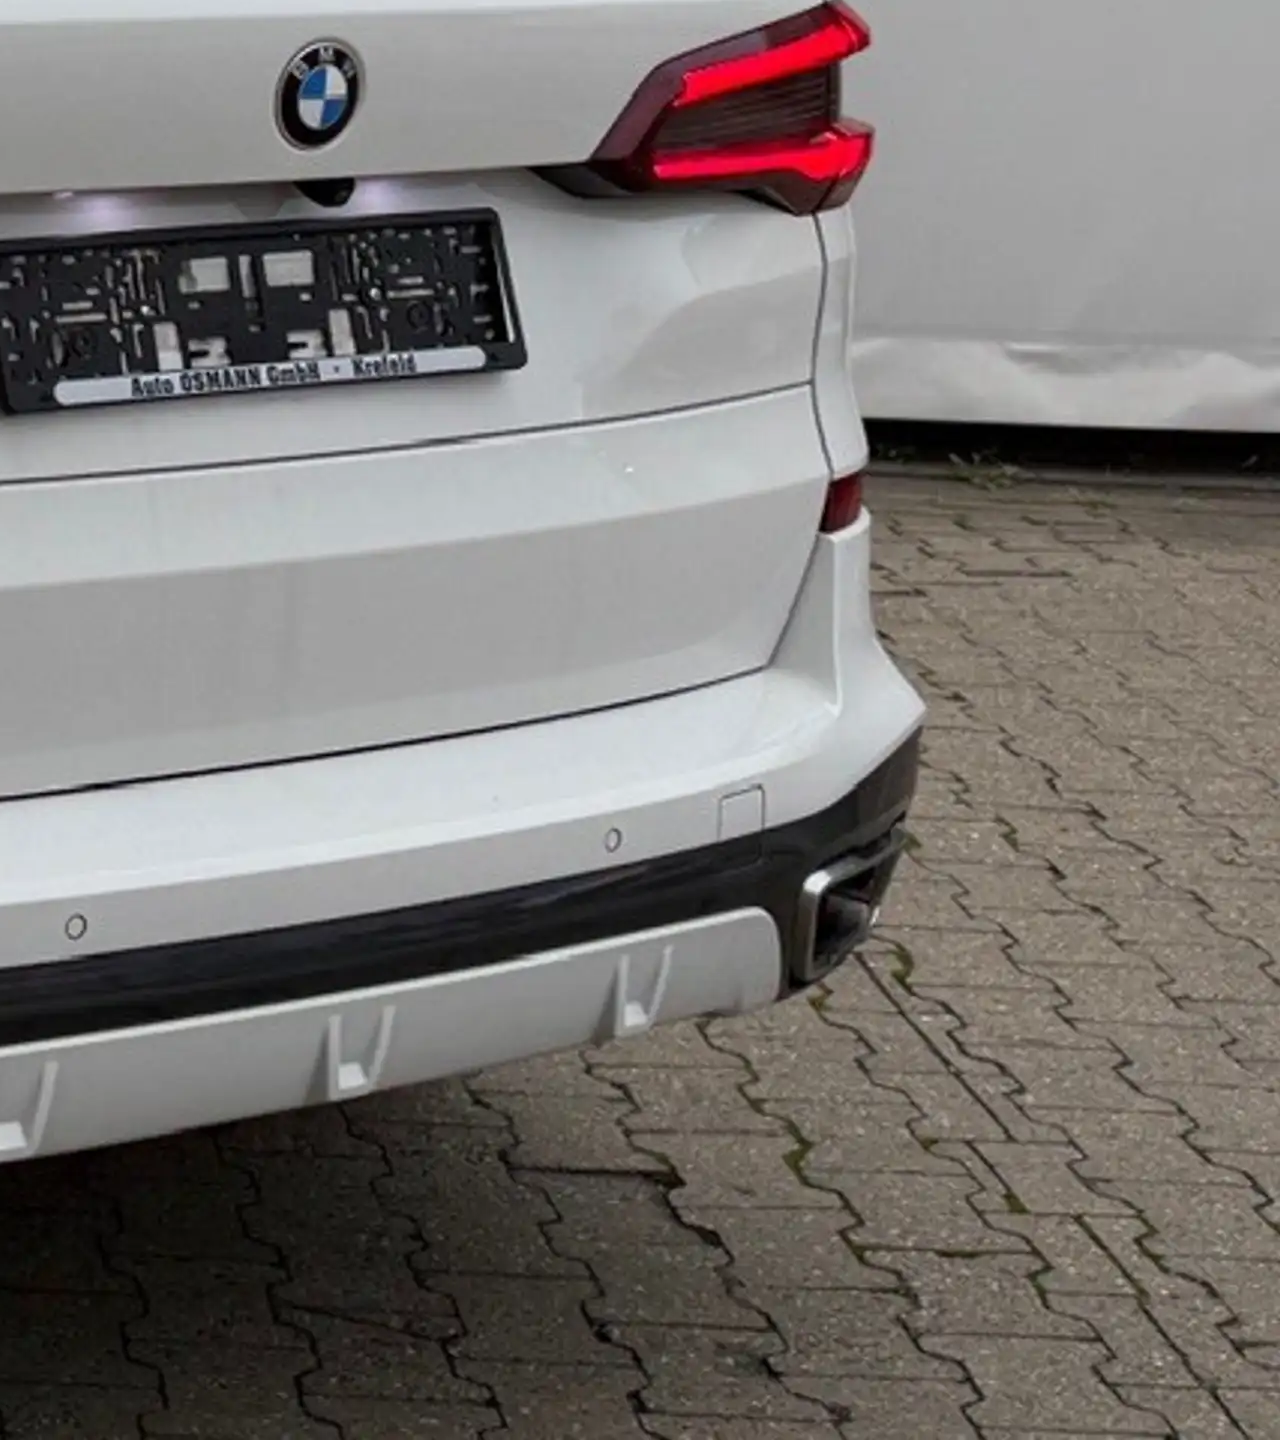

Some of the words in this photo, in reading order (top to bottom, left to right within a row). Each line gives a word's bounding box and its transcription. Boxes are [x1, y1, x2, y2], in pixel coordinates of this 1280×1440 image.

[131, 376, 175, 398] Auto
[179, 364, 262, 393] OSMANN
[266, 359, 321, 386] GmbH
[352, 352, 418, 378] Krefeld
